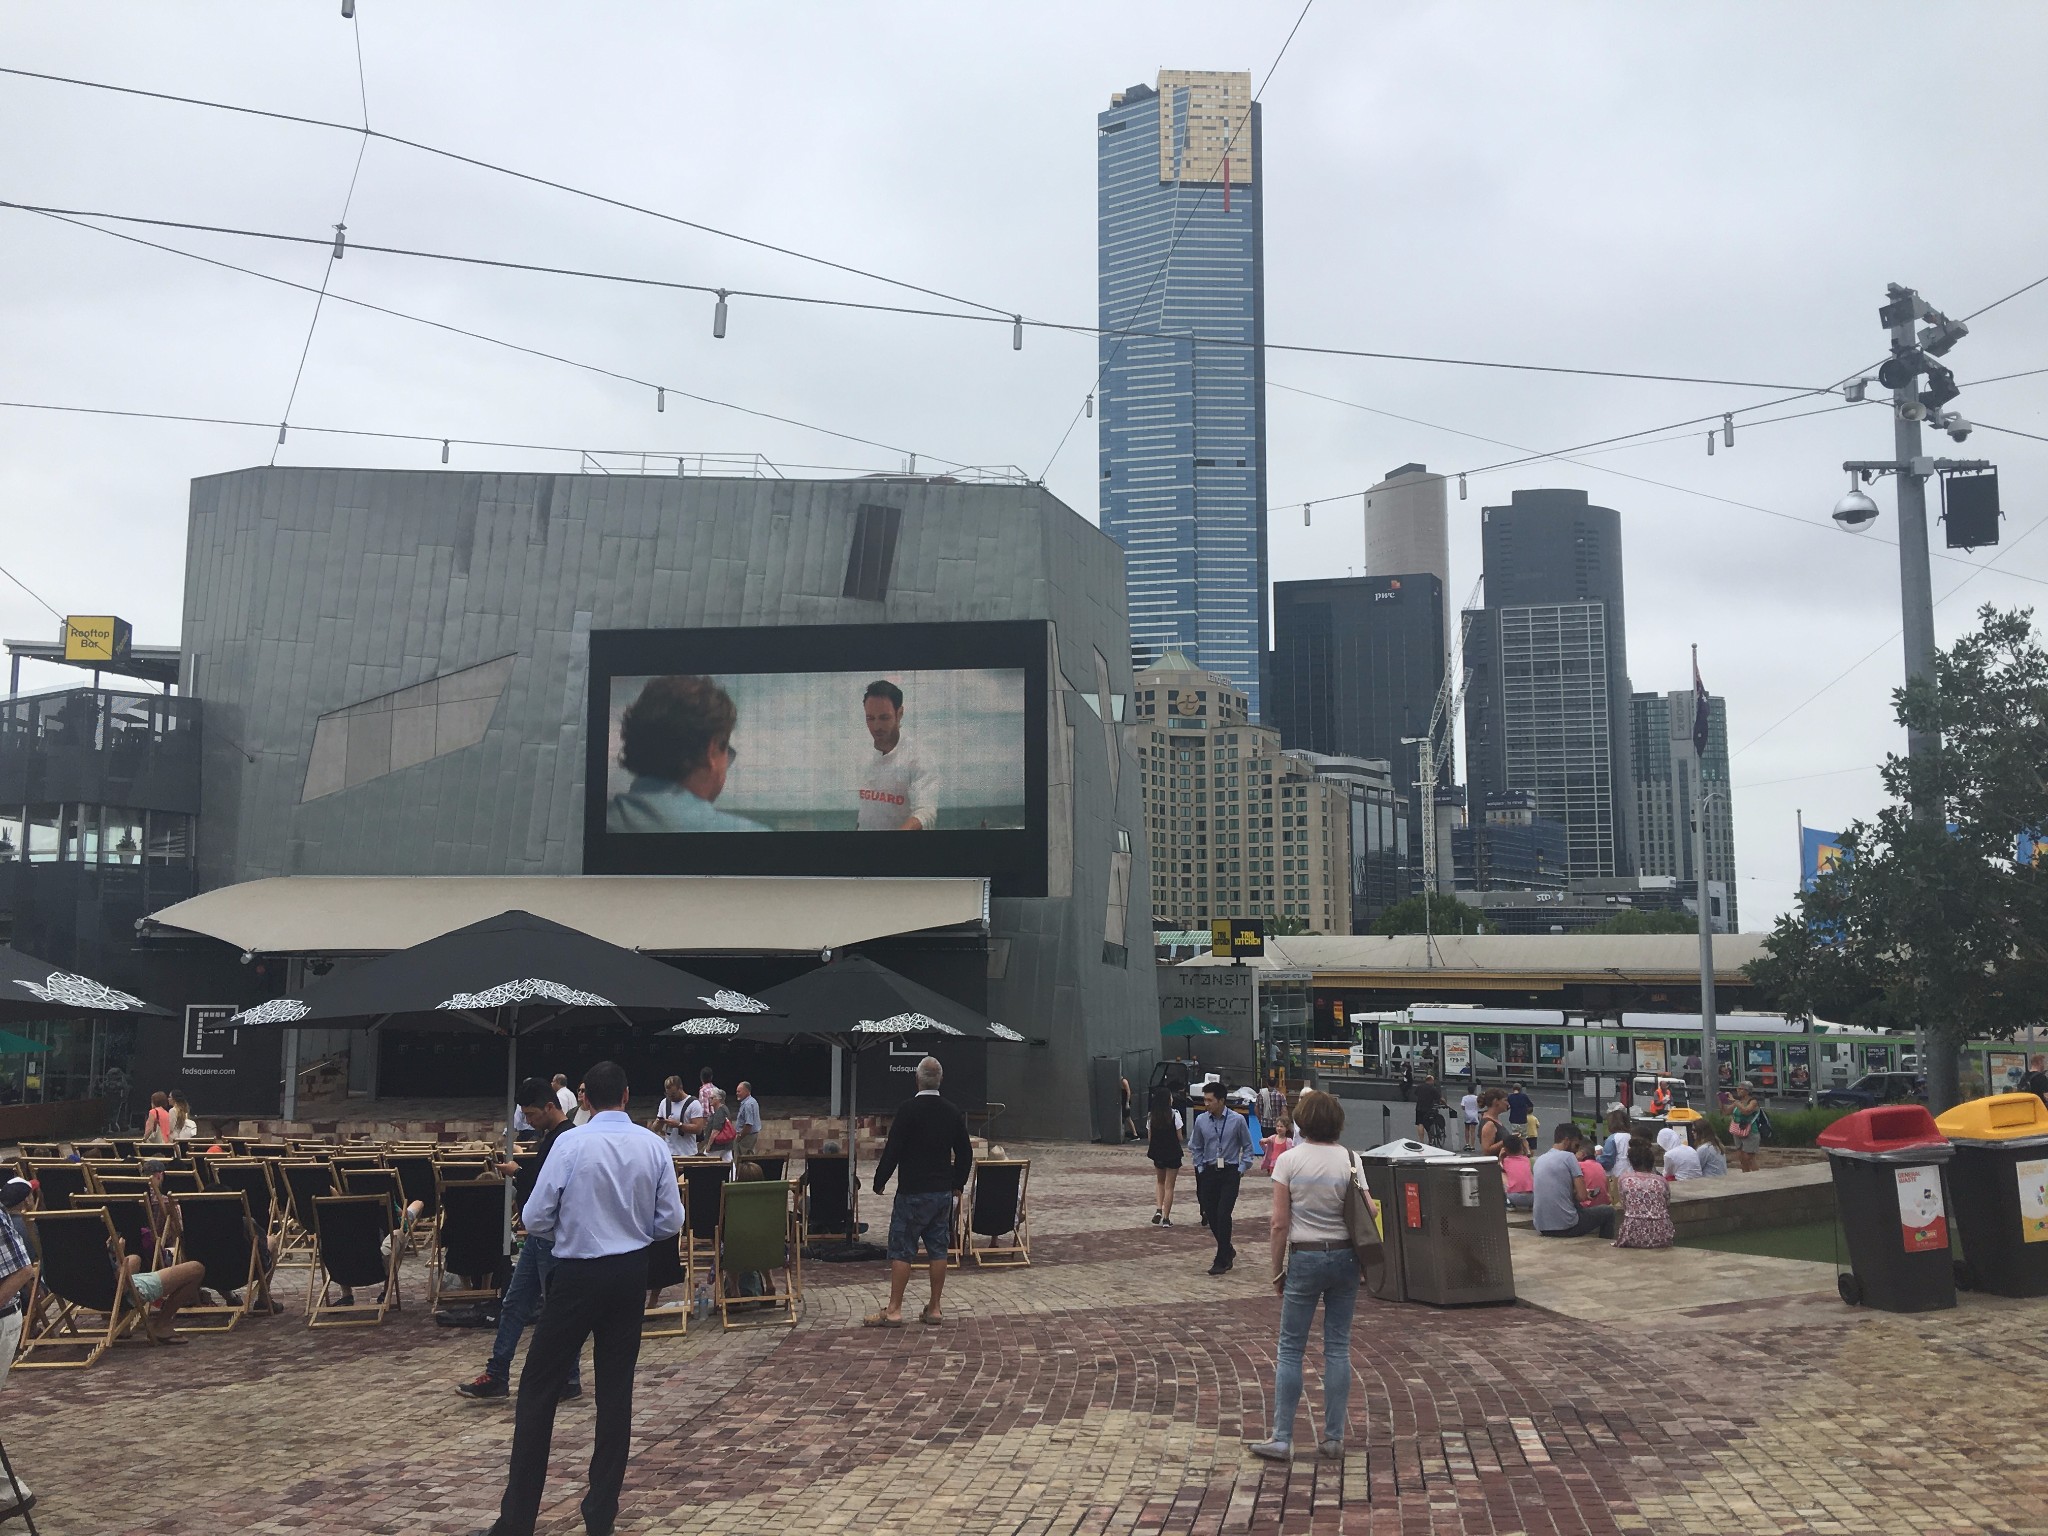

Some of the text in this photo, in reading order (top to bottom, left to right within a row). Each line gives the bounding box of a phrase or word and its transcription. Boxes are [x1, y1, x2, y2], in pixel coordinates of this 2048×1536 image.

[1374, 592, 1396, 601] pwc
[71, 629, 110, 639] Rooftop
[81, 640, 99, 648] Bar
[1208, 671, 1232, 686] Langham
[1235, 938, 1261, 946] KITCHEN
[1159, 996, 1250, 1010] RANSPORT
[182, 1067, 236, 1076] fedsquare.com
[1898, 1171, 1921, 1180] GENERAL
